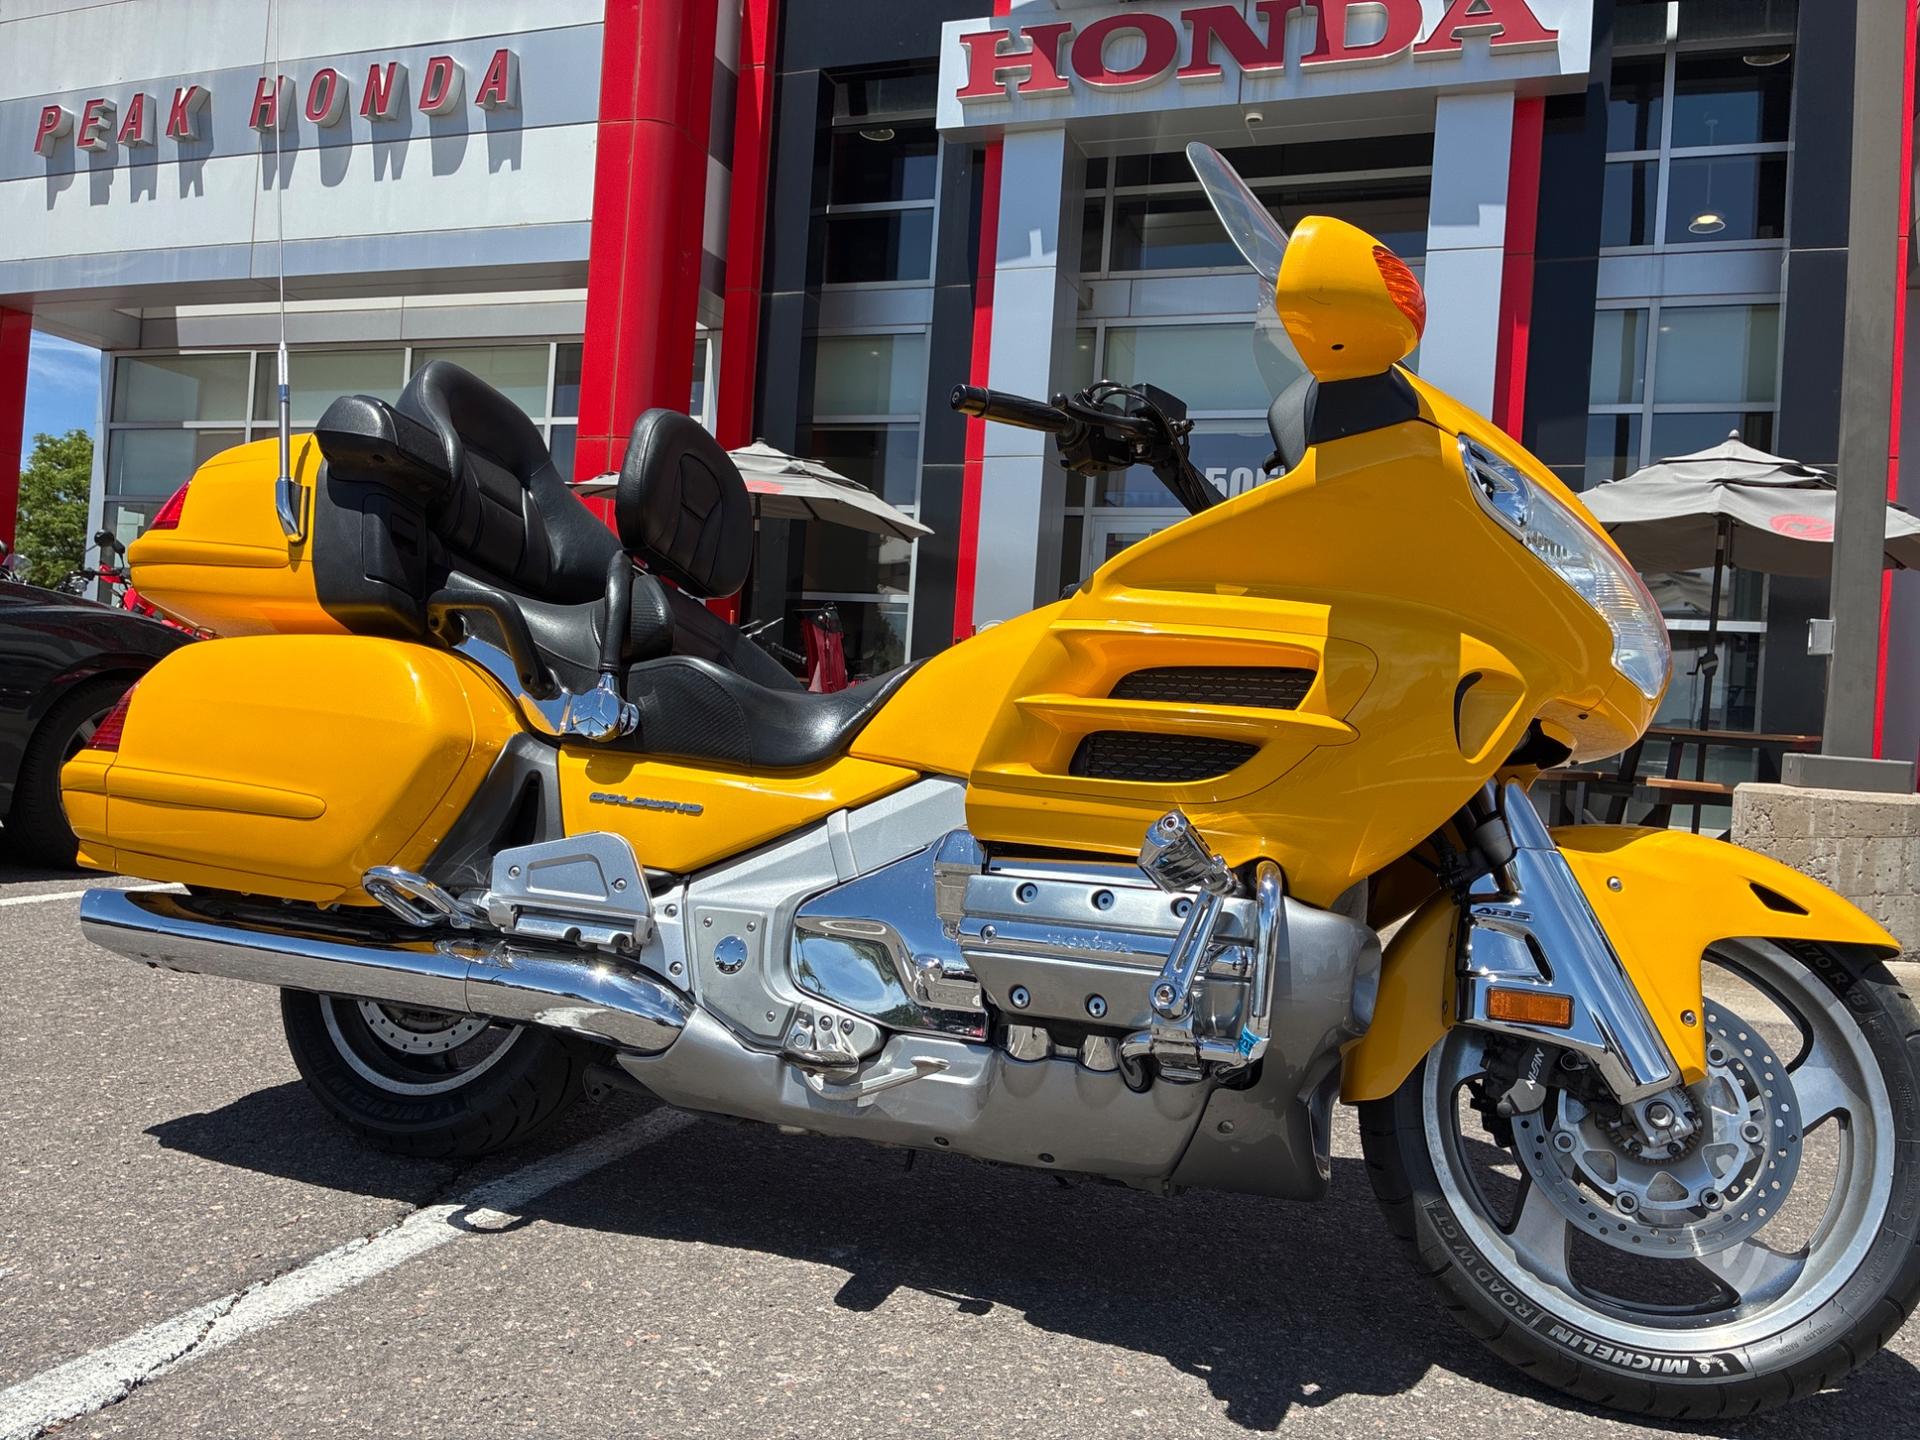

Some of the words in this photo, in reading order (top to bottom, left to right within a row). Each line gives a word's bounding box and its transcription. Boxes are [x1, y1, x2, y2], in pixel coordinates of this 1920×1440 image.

[956, 0, 1560, 102] HONDA
[33, 84, 209, 156] PEAK
[248, 48, 515, 131] HONDA
[1473, 905, 1535, 922] ABS
[1475, 1267, 1535, 1319] ROAD
[1547, 1323, 1690, 1375] MICHELIN
